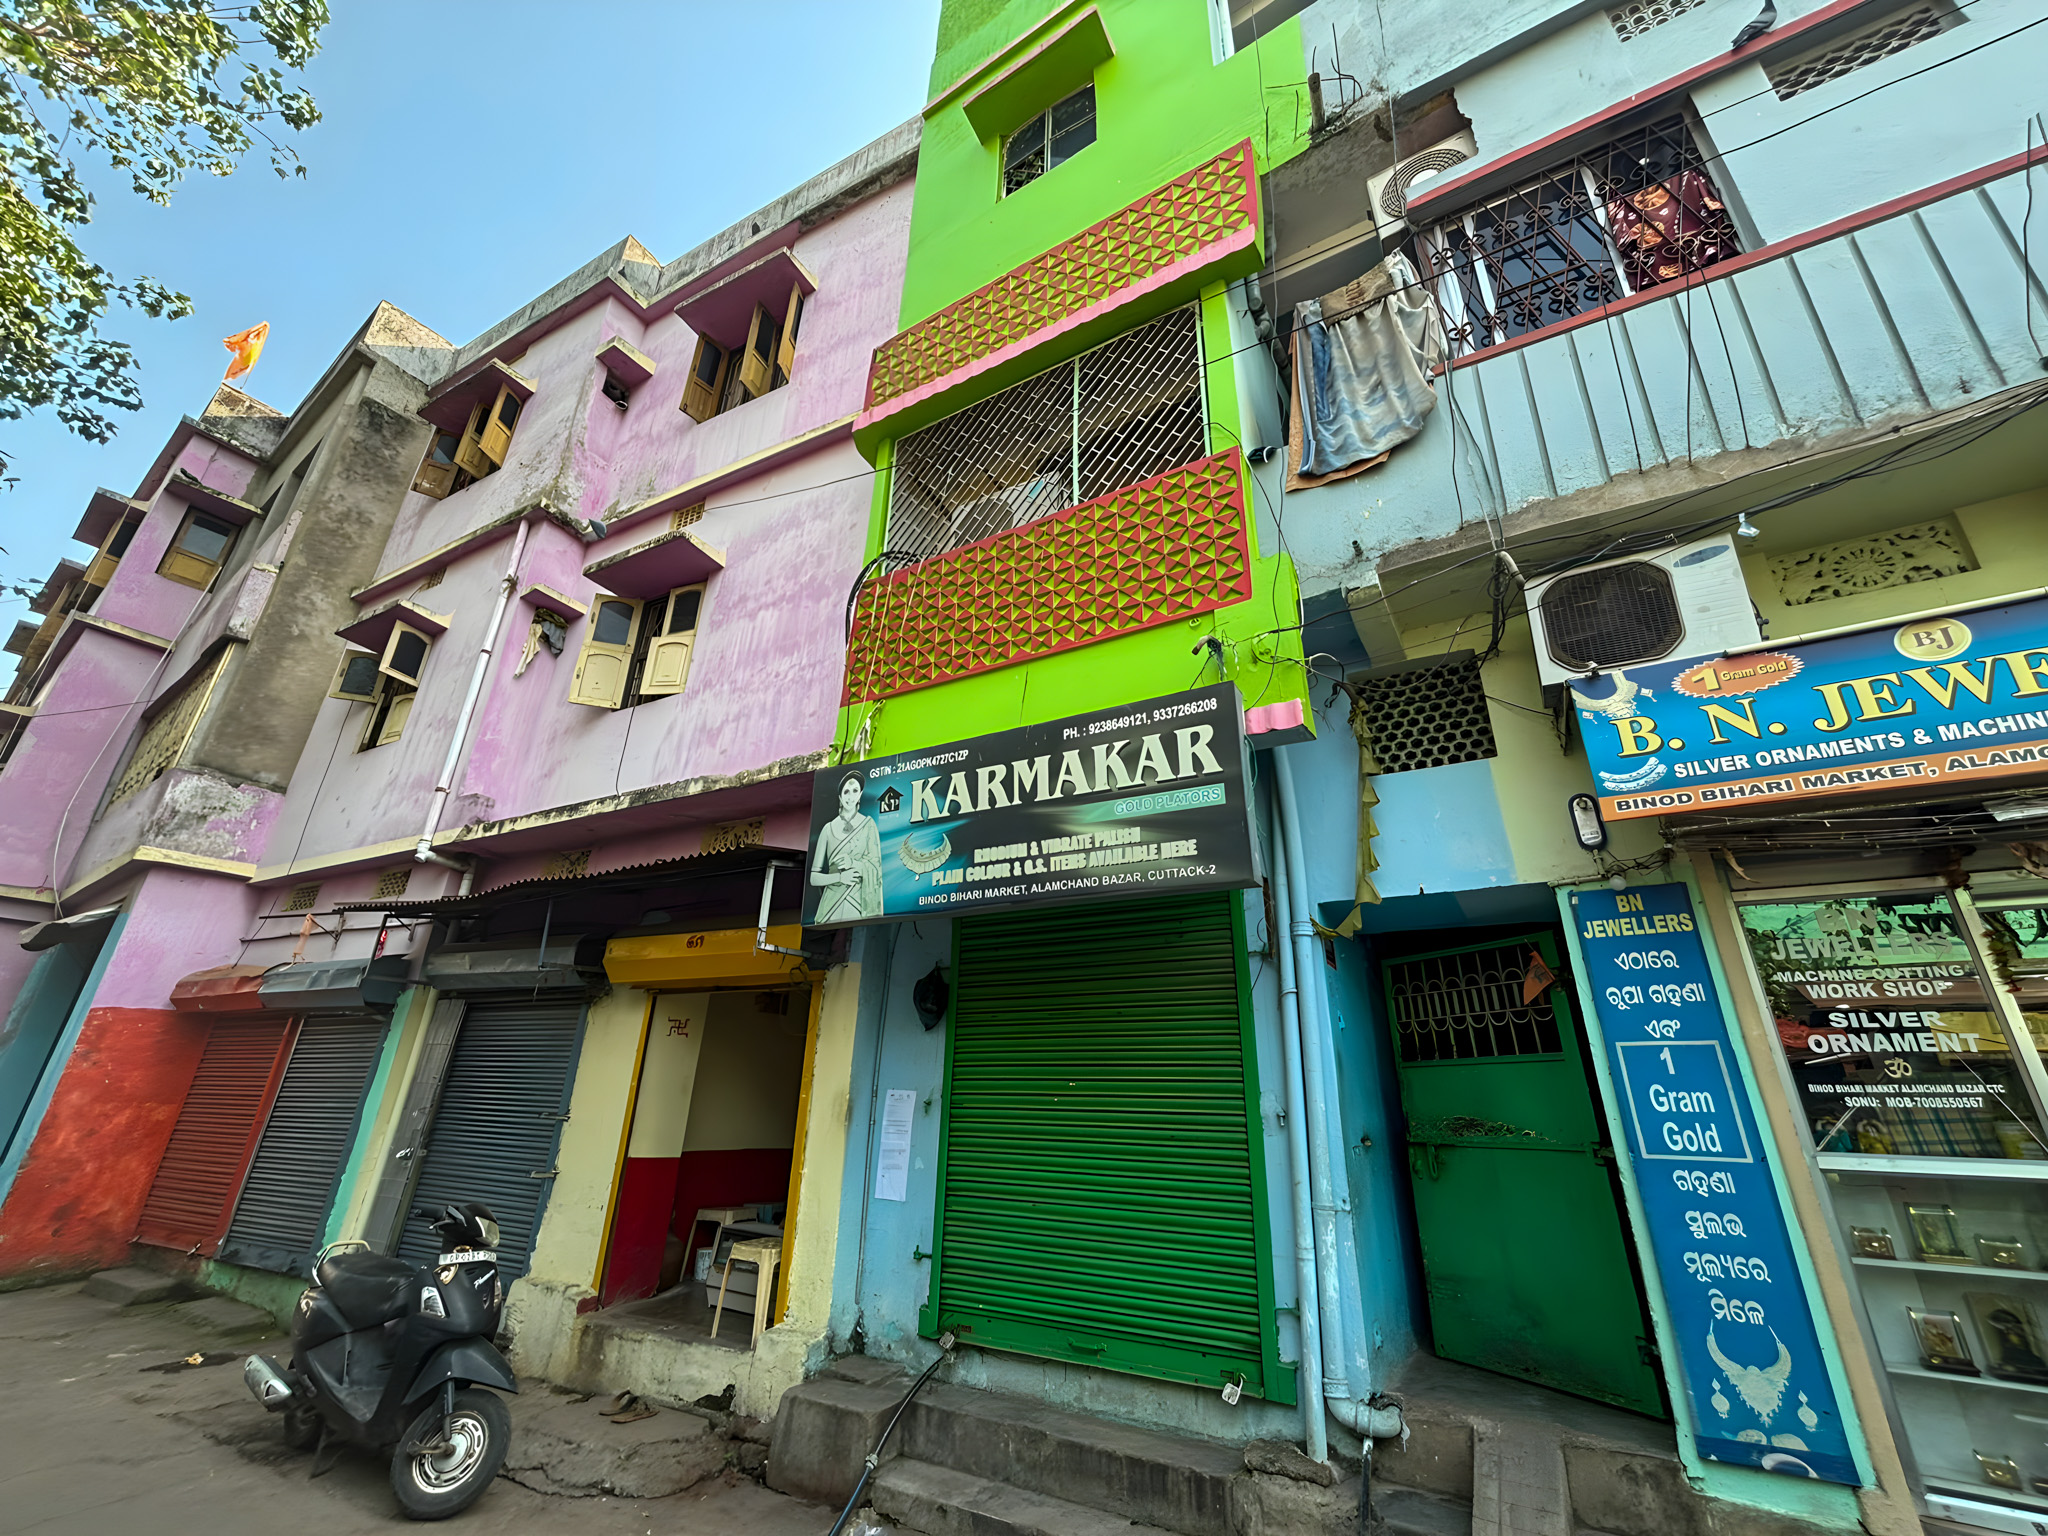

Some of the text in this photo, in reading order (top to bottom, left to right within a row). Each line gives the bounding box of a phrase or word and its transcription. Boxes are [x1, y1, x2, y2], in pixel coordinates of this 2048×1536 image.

[1912, 626, 1955, 650] BJ
[1692, 661, 1787, 691] 1 Gram Gold
[1088, 713, 1151, 735] 9238649121,
[1153, 698, 1218, 721] 9337266208
[1609, 715, 1685, 757] B.
[1698, 697, 1787, 744] N.
[1673, 754, 1748, 778] SILVER
[1756, 731, 1905, 768] ORNAMENTS
[1913, 728, 1933, 745] &
[910, 724, 1224, 824] KARMAKAR
[1615, 791, 1693, 812] BINOD
[1702, 777, 1792, 802] BIHARI
[1802, 761, 1939, 789] MARKET,
[1114, 788, 1221, 815] GOLD PLATORS
[1030, 841, 1039, 856] &
[931, 868, 964, 887] PLAIN
[966, 862, 1011, 882] COLOUR
[1013, 860, 1022, 876] &
[1050, 853, 1087, 872] ITEMS
[1089, 844, 1159, 868] AVAILABLE
[1160, 838, 1198, 860] HERE
[919, 894, 948, 906] BINOD
[950, 889, 983, 903] BIHARI
[985, 884, 1029, 898] MARKET,
[1030, 876, 1099, 894] ALAMCHAND
[1147, 864, 1217, 881] CUTTACK-2
[1615, 893, 1644, 913] BN
[1583, 912, 1694, 939] JEWELLERS
[1814, 906, 1878, 933] BN
[1771, 931, 1953, 961] JEWELLERS
[1614, 949, 1680, 971] ଏଠାରେ
[1776, 968, 1865, 983] MACHINE
[1649, 982, 1707, 1007] ଗହଣା
[1805, 983, 1879, 999] WORK
[1644, 1019, 1681, 1039] ଏବଂ
[1828, 1011, 1947, 1028] SILVER
[1807, 1033, 1980, 1053] ORNAMENT
[1659, 1046, 1676, 1075] 1
[1649, 1084, 1716, 1113] Gram
[1808, 1084, 1835, 1093] BINOD
[1986, 1084, 2006, 1093] CTC
[1844, 1096, 1882, 1107] SONU:
[1662, 1121, 1723, 1153] Gold
[1673, 1169, 1737, 1197] ଗହଣା
